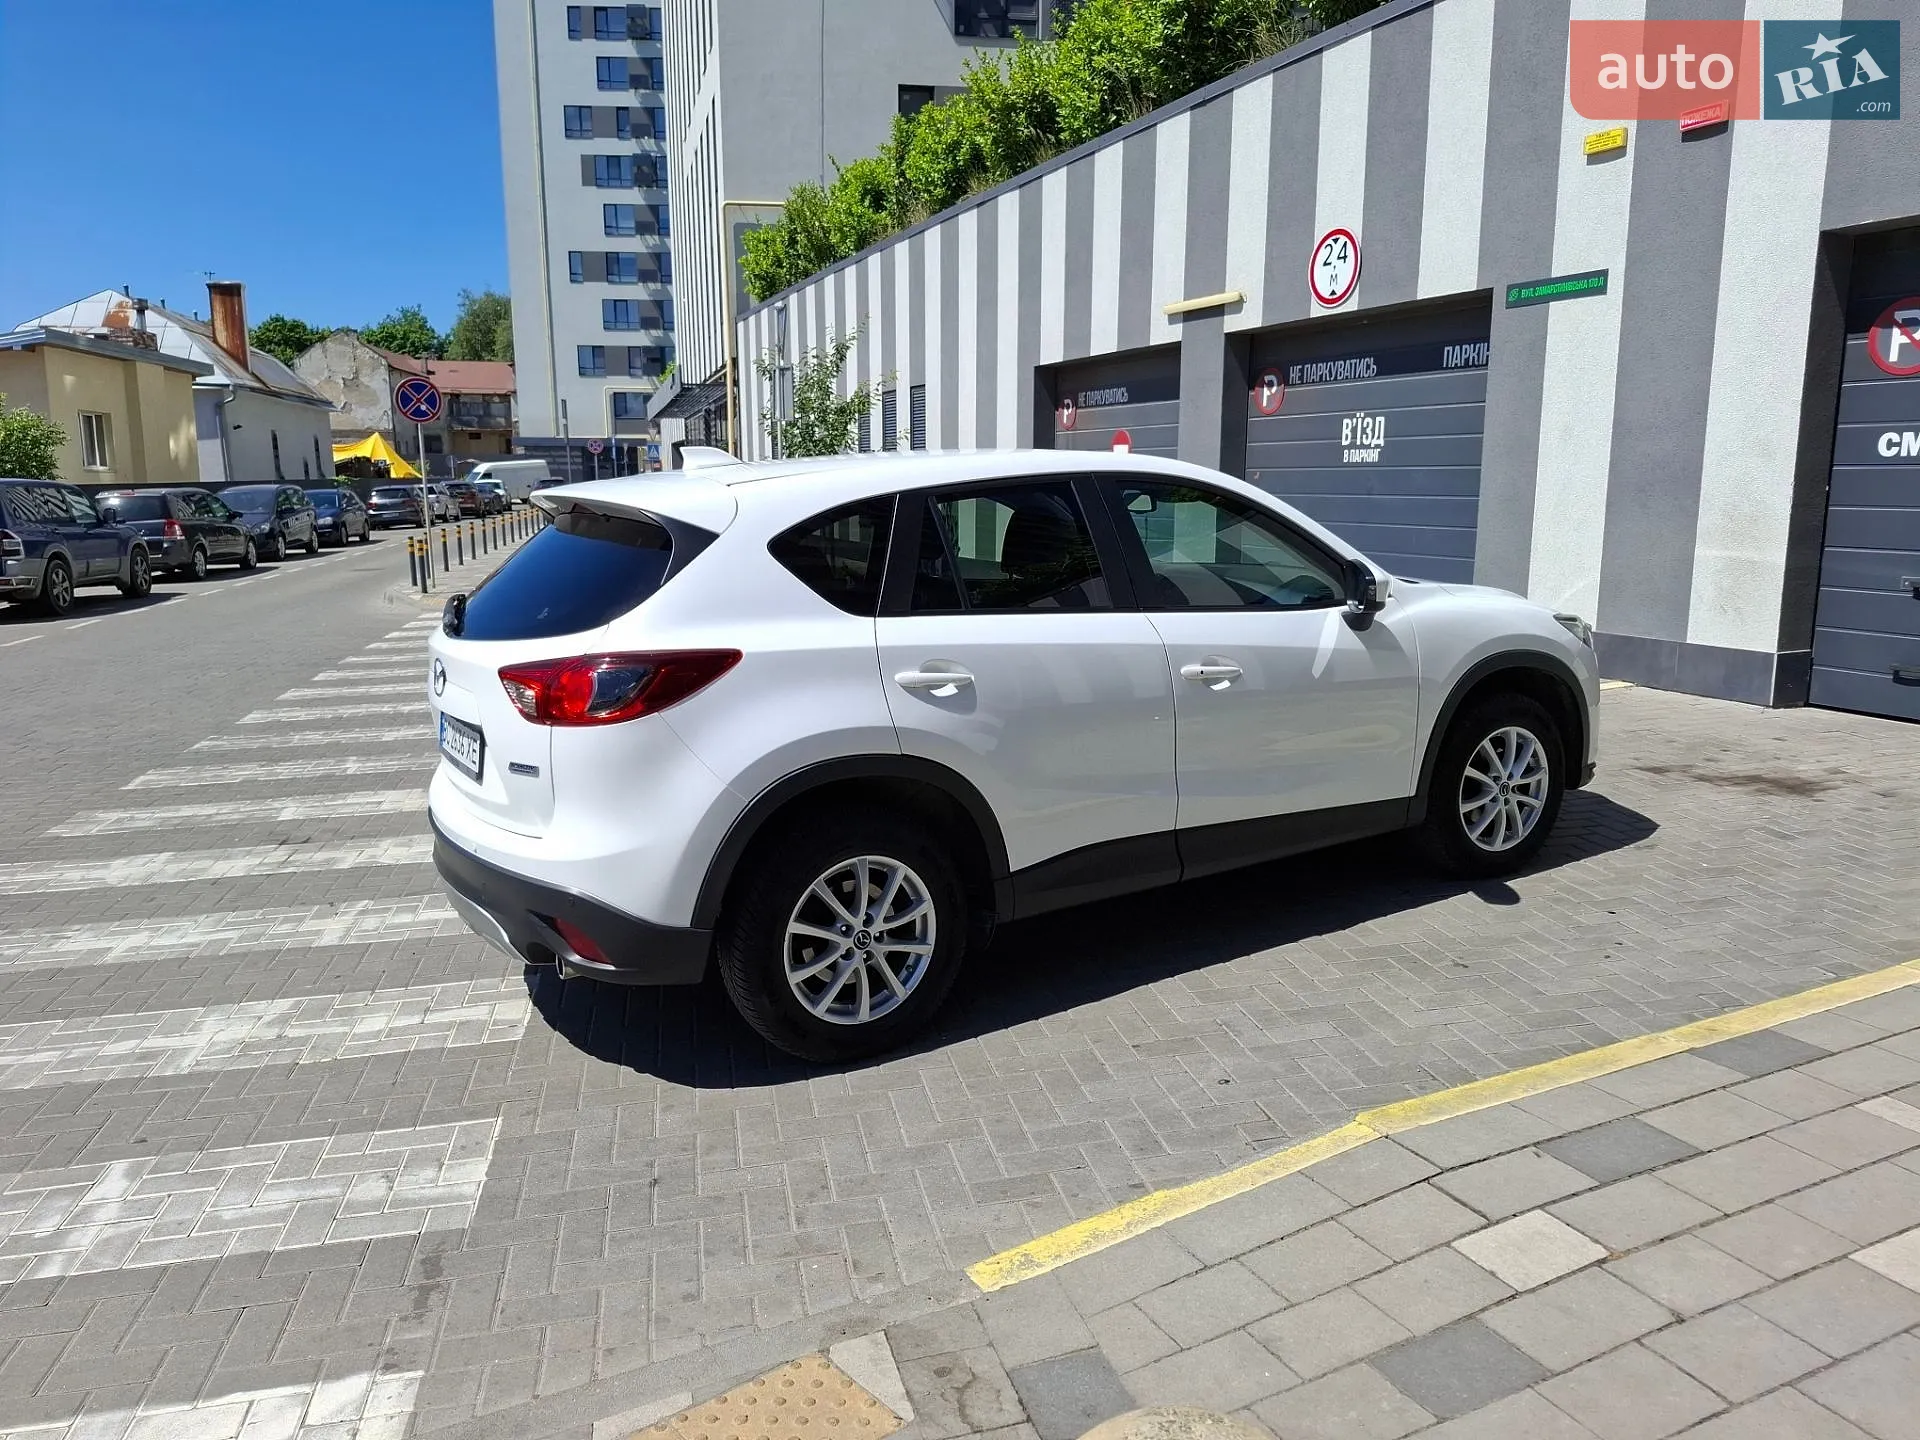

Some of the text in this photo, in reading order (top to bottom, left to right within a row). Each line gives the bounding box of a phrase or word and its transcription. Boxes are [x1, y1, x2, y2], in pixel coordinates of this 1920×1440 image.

[1322, 240, 1348, 272] 2,4
[1289, 356, 1377, 385] НЕ ПАРКУВАТИСЬ
[1078, 387, 1129, 408] НЕ ПАРКУВАТИСЬ
[1341, 412, 1385, 448] В'ЇЗД
[1349, 448, 1381, 463] ПАРКІНГ
